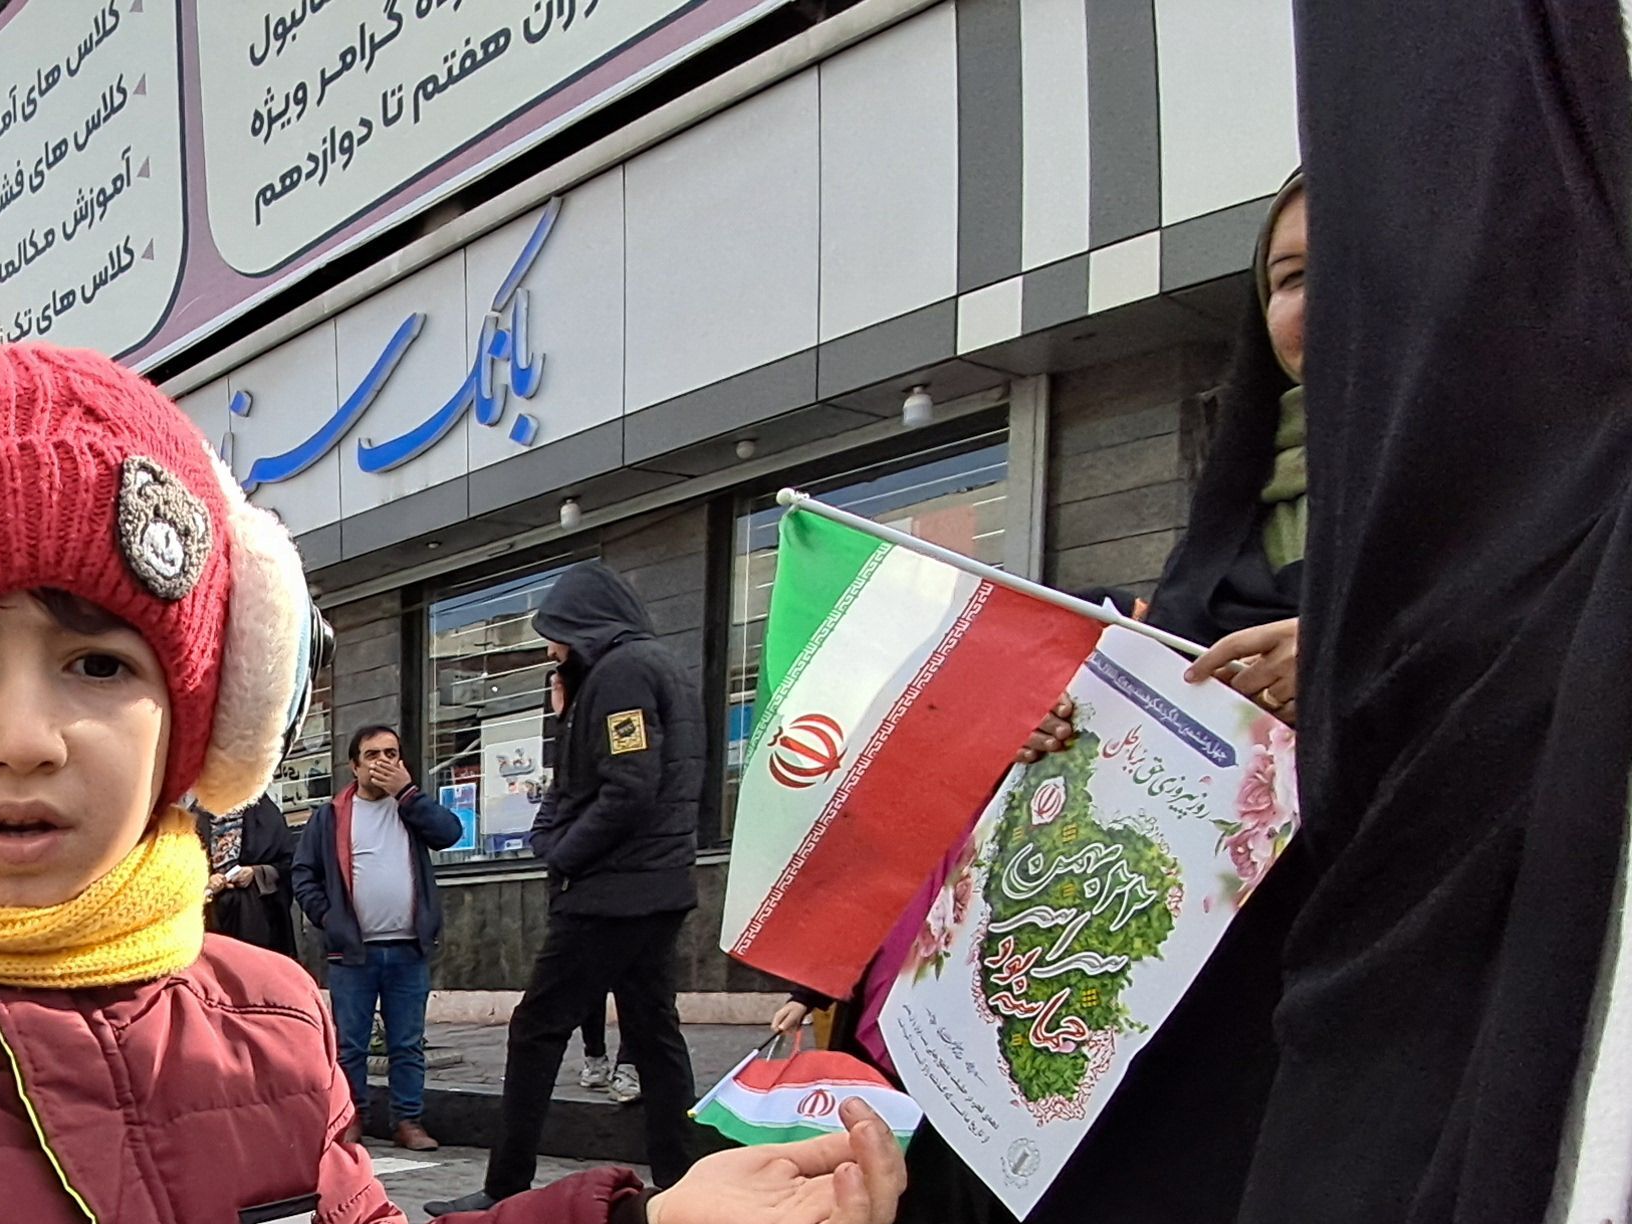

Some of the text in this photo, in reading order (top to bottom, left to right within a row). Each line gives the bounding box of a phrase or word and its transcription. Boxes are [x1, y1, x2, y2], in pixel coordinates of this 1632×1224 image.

[66, 0, 121, 78] کلاس
[317, 0, 404, 108] گرامر
[413, 27, 512, 124] هفتم
[21, 64, 61, 122] های
[73, 73, 128, 152] کلاس
[251, 81, 308, 145] ویژه
[381, 83, 404, 128] تا
[28, 137, 68, 194] های
[62, 145, 132, 241] آموزش
[255, 116, 374, 227] دوازدهم
[80, 234, 135, 305] کلاس
[36, 289, 77, 336] های
[357, 195, 564, 447] بانک
[1132, 756, 1165, 785] حق
[1147, 775, 1200, 820] پیروزی
[1185, 792, 1210, 820] روز
[1001, 842, 1158, 932] ۲۲ بهمن
[987, 905, 1129, 979] سراسر
[984, 935, 1089, 1050] حماسه بود
